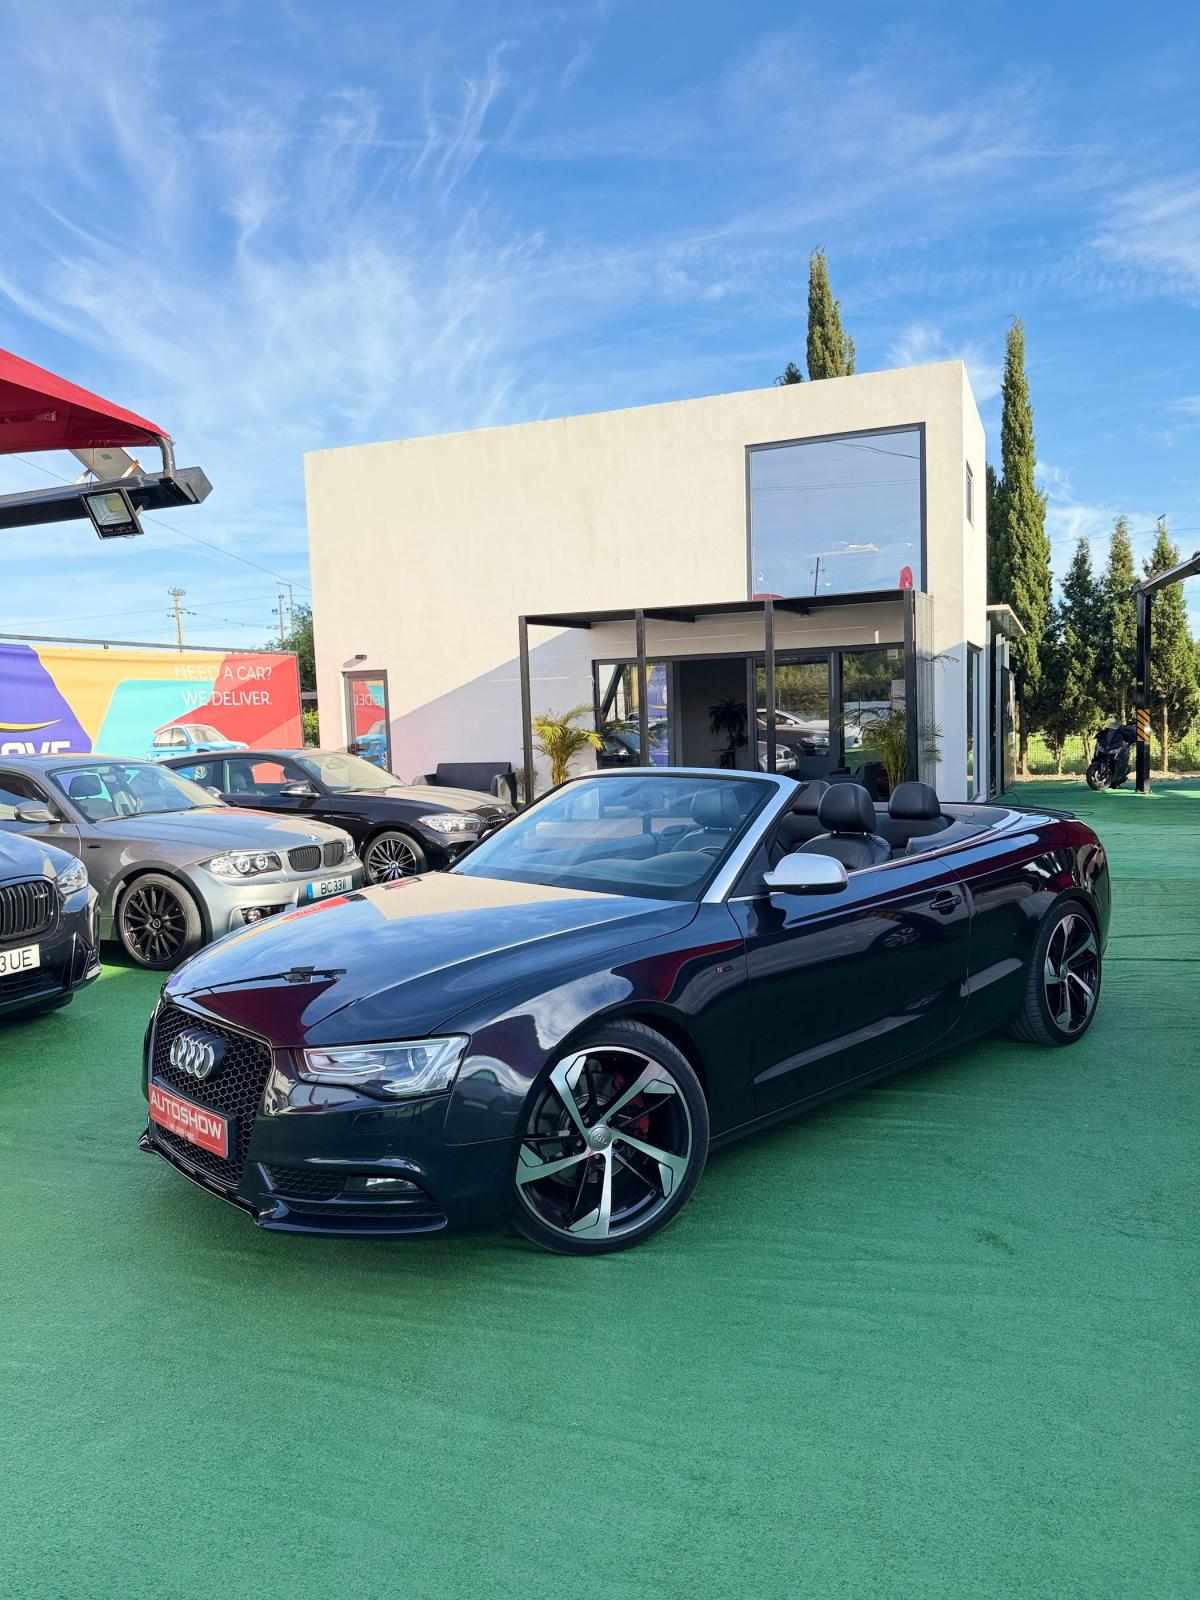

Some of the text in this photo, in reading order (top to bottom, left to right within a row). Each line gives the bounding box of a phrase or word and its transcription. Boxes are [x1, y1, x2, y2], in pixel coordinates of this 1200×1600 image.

[223, 666, 234, 680] A
[237, 665, 272, 680] CAR?
[182, 689, 272, 706] WE DELIVER.
[150, 1089, 222, 1140] AUTOSHOW
